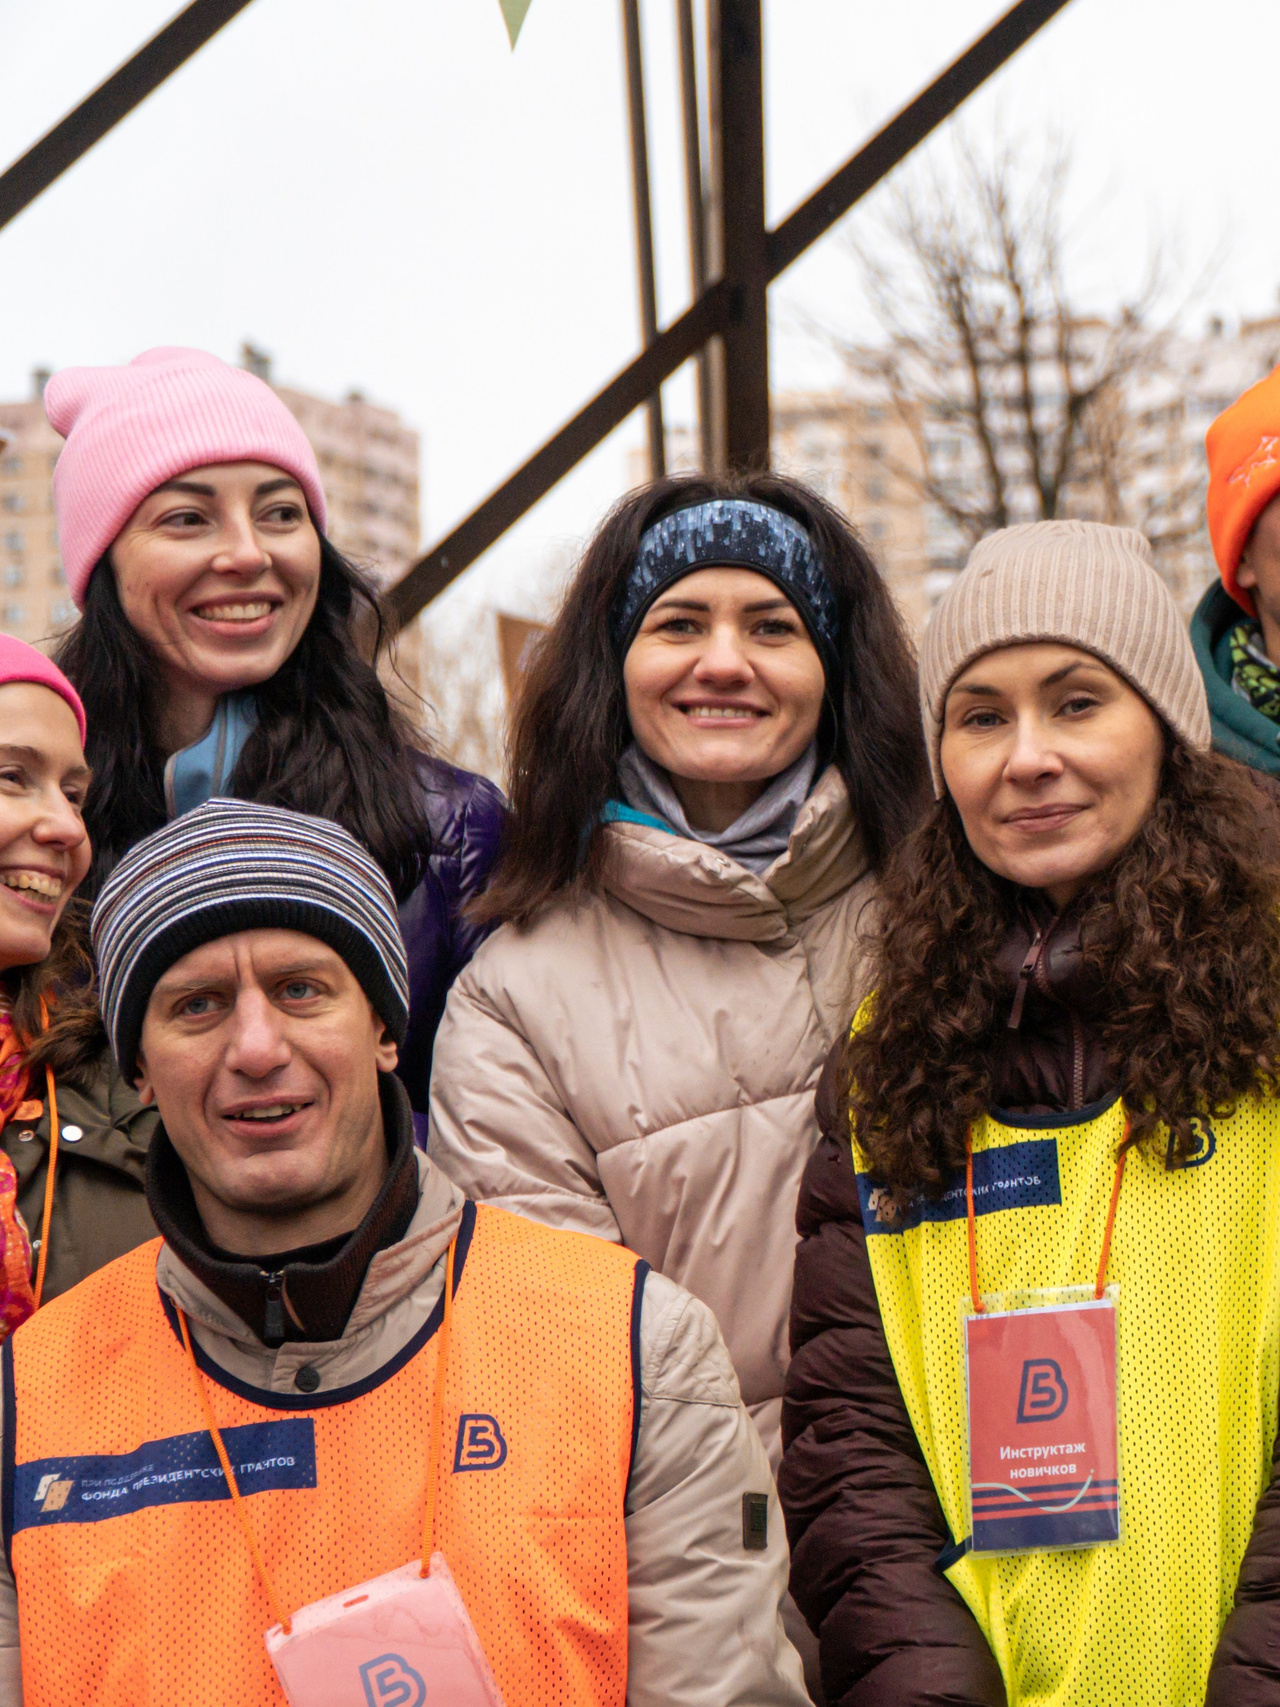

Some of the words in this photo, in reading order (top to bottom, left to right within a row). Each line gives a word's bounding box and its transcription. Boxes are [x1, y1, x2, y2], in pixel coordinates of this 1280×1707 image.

[999, 1441, 1087, 1462] Инструктаж
[81, 1486, 129, 1501] ФОНДА
[240, 1456, 296, 1474] ГРАНТОВ
[1009, 1463, 1078, 1480] новичков
